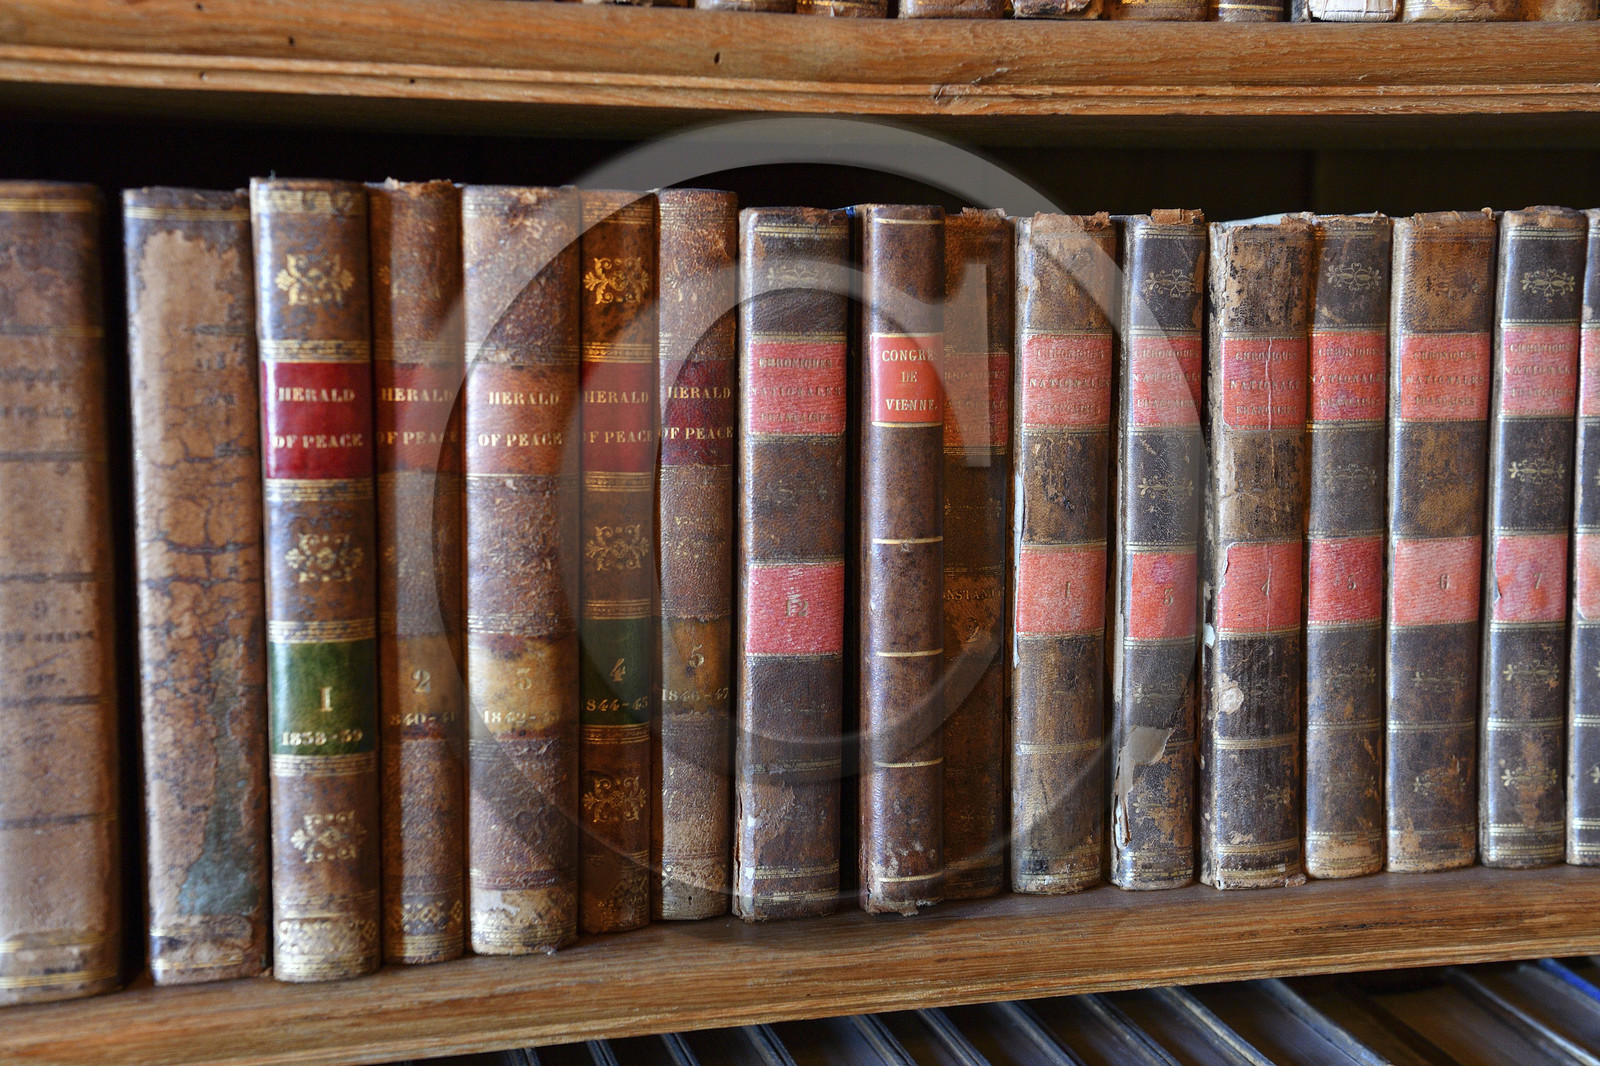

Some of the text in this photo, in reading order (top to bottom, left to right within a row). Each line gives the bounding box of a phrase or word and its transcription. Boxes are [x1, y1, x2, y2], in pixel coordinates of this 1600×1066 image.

[901, 371, 918, 383] DE
[278, 387, 356, 402] HERALD
[381, 387, 455, 402] HERALD
[488, 391, 560, 405] HERALD
[584, 390, 649, 404] HERALD
[667, 386, 731, 399] HERALD
[885, 398, 938, 411] VIENNE.
[477, 432, 562, 447] OF PEACE
[604, 429, 653, 444] PEACE
[685, 426, 733, 440] PEACE
[271, 433, 363, 449] OF PEACE
[1533, 572, 1543, 590] 7
[688, 644, 705, 669] 5
[609, 658, 626, 682] 4
[412, 669, 432, 693] 2
[320, 686, 333, 712] 1
